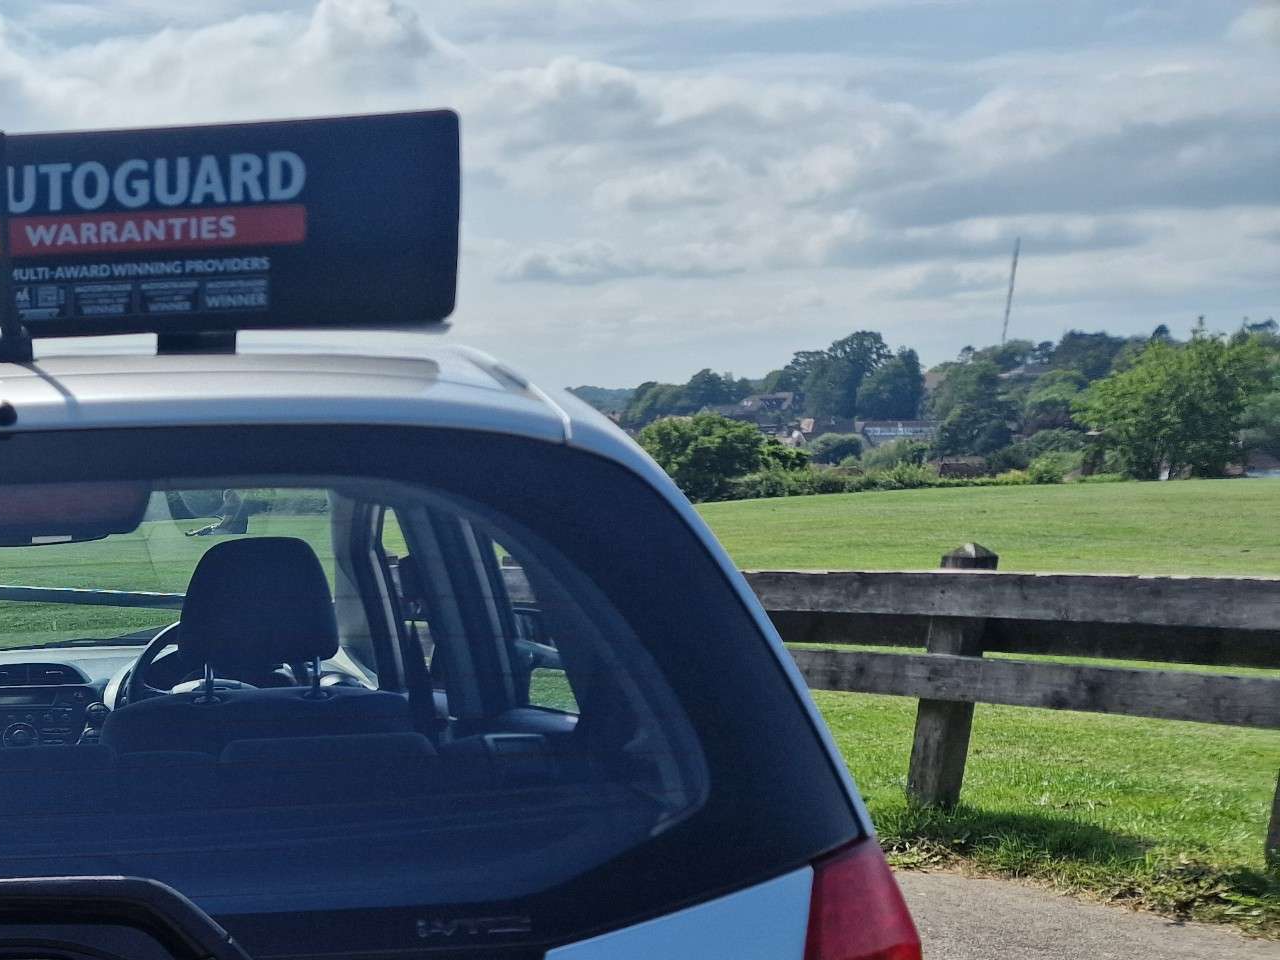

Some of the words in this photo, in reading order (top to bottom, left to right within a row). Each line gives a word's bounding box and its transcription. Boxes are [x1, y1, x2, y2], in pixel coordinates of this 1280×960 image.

[25, 215, 237, 248] WARRANTIES
[111, 260, 183, 277] WINNING
[185, 256, 271, 273] PROVIDERS
[206, 293, 268, 308] WINNER
